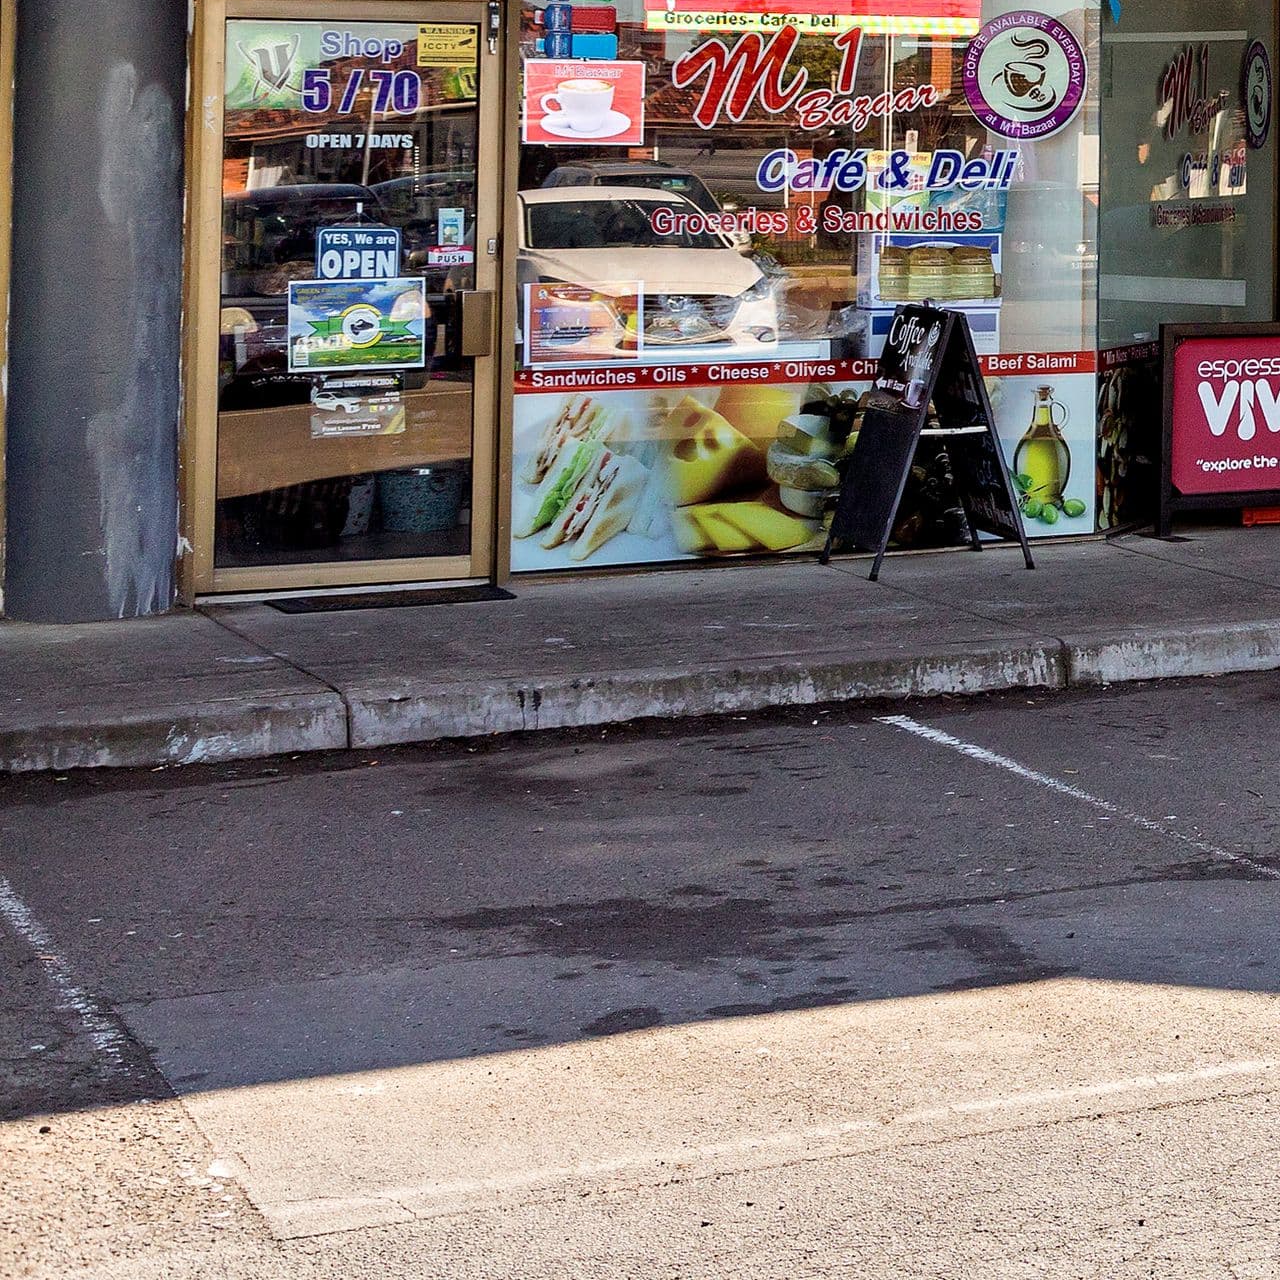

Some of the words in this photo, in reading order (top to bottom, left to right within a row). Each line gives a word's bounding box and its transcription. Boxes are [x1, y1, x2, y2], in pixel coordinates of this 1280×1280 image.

[321, 31, 404, 63] Shop
[966, 34, 988, 78] COFFEE
[989, 15, 1049, 35] AVAILABLE
[1051, 26, 1080, 61] EVERY
[1071, 62, 1081, 86] DAY
[672, 24, 808, 130] M
[834, 25, 863, 95] 1
[795, 83, 937, 132] Bazaar
[985, 113, 997, 125] at
[1021, 116, 1057, 135] Bazaar
[306, 134, 352, 148] OPEN
[355, 134, 365, 148] 7
[368, 134, 414, 148] DAYS
[755, 148, 873, 192] Café
[878, 148, 912, 191] &
[925, 148, 1019, 191] Deli
[651, 206, 788, 235] Groceries
[794, 206, 817, 234] &
[823, 205, 983, 234] Sandwiches
[324, 234, 352, 246] YES,
[355, 234, 373, 245] We
[375, 236, 396, 245] are
[321, 249, 396, 278] OPEN
[889, 315, 925, 354] Coffee
[531, 366, 637, 387] Sandwiches
[652, 364, 687, 382] Oils
[707, 362, 769, 380] Cheese
[785, 359, 836, 377] Olives
[852, 357, 878, 376] Chi
[987, 353, 1023, 371] Beef
[1026, 352, 1078, 369] Salami
[1254, 455, 1278, 468] the
